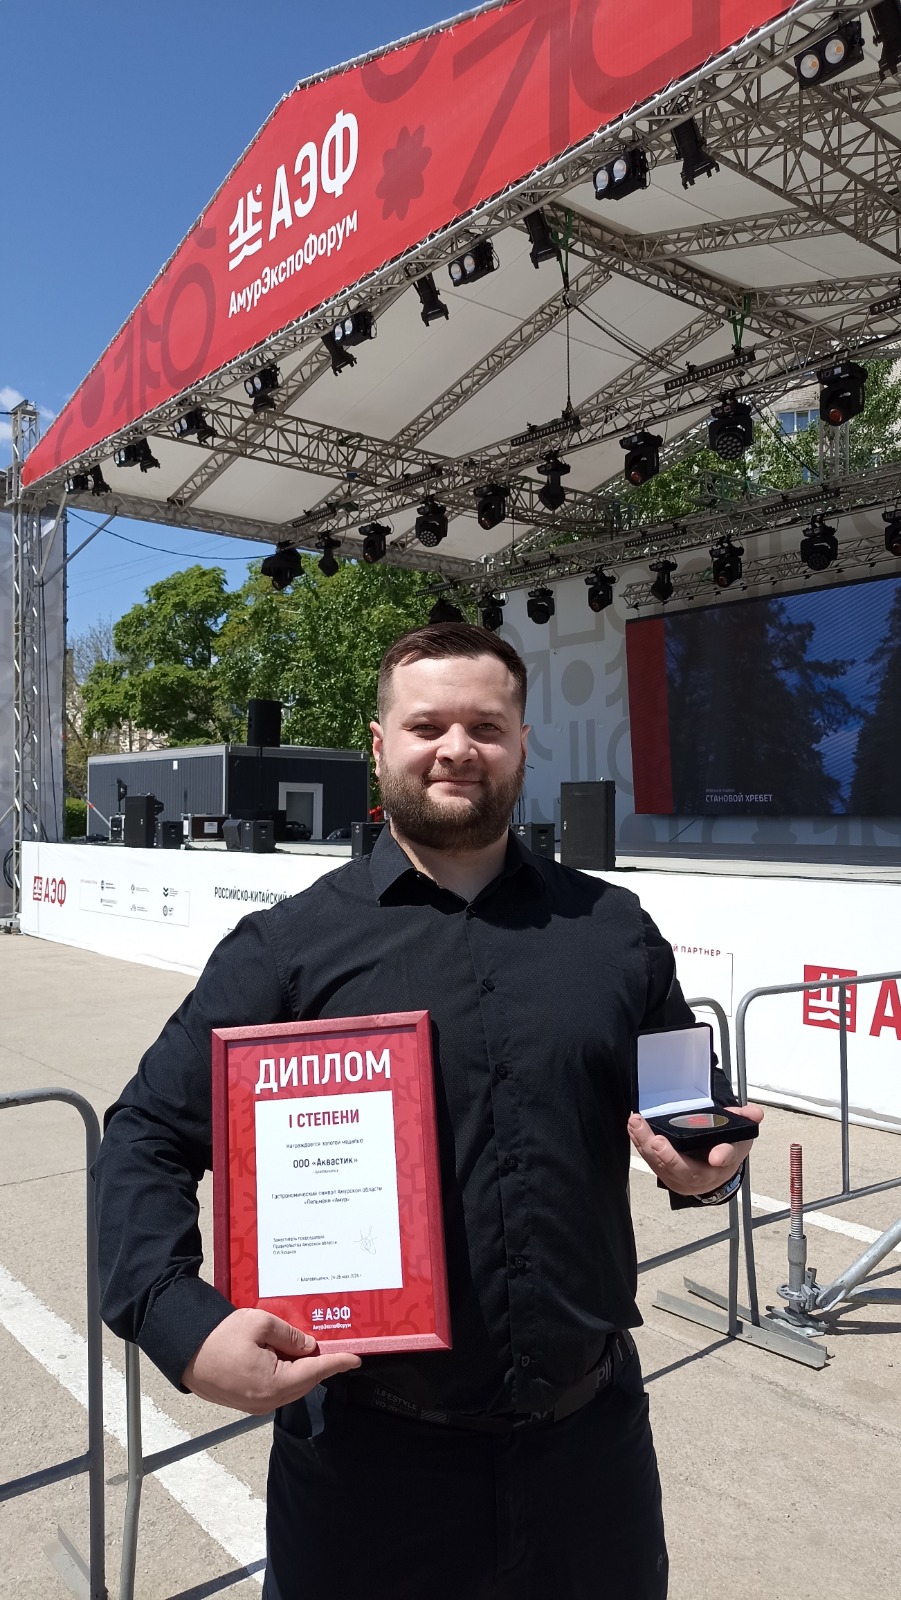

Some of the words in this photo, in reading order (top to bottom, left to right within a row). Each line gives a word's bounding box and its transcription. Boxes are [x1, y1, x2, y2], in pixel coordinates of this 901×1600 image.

[269, 109, 359, 242] АЭФ
[228, 210, 358, 318] АмурЭкспоФорум
[705, 792, 744, 803] СТАНОВОЙ
[745, 794, 773, 803] ХРЕБЕТ
[43, 877, 67, 907] АЭФ
[680, 945, 721, 957] ПАРТНЕР
[255, 1048, 391, 1094] ДИПЛОМ
[297, 1109, 360, 1128] СТЕПЕНИ
[293, 1158, 310, 1168] ООО
[312, 1157, 358, 1167] «Аквастик»
[325, 1306, 351, 1321] АЭФ
